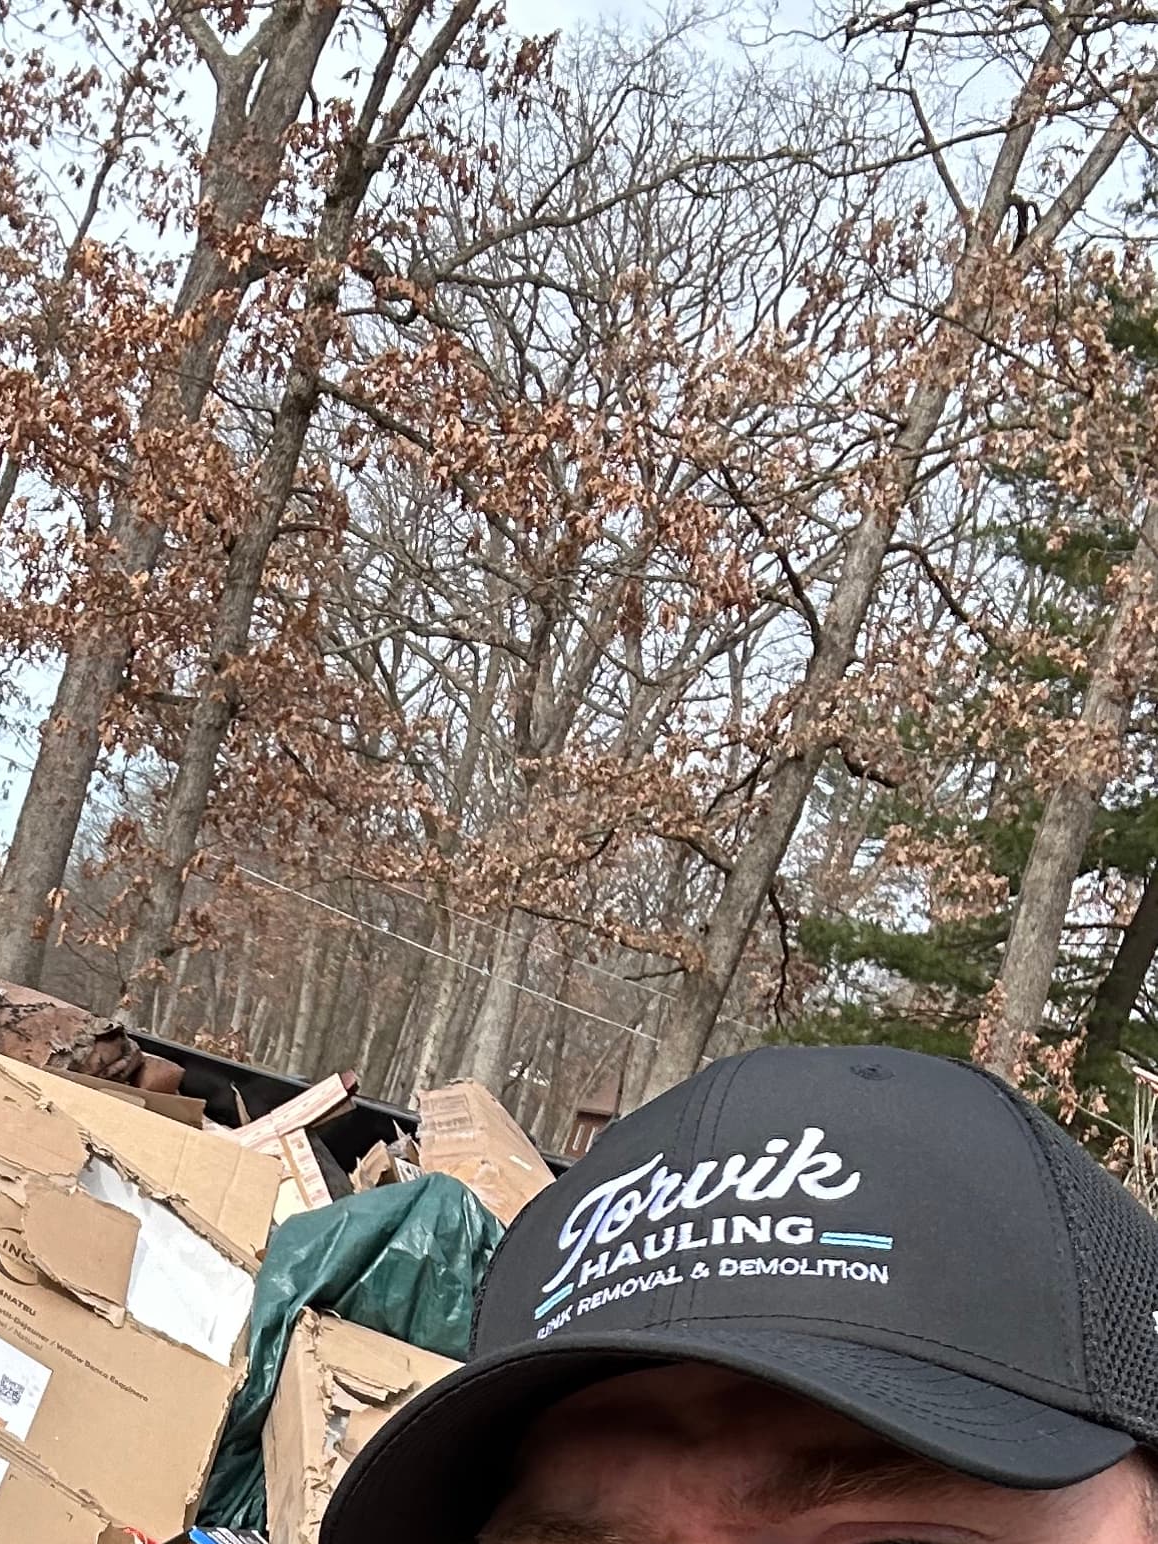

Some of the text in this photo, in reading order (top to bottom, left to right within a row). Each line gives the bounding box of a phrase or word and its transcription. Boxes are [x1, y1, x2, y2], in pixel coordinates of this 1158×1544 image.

[542, 1126, 861, 1293] Torvik
[577, 1215, 814, 1289] HAULING
[577, 1265, 683, 1322] REMOVAL
[690, 1262, 710, 1279] &
[718, 1256, 889, 1285] DEMOLITION
[54, 1342, 85, 1364] Willow
